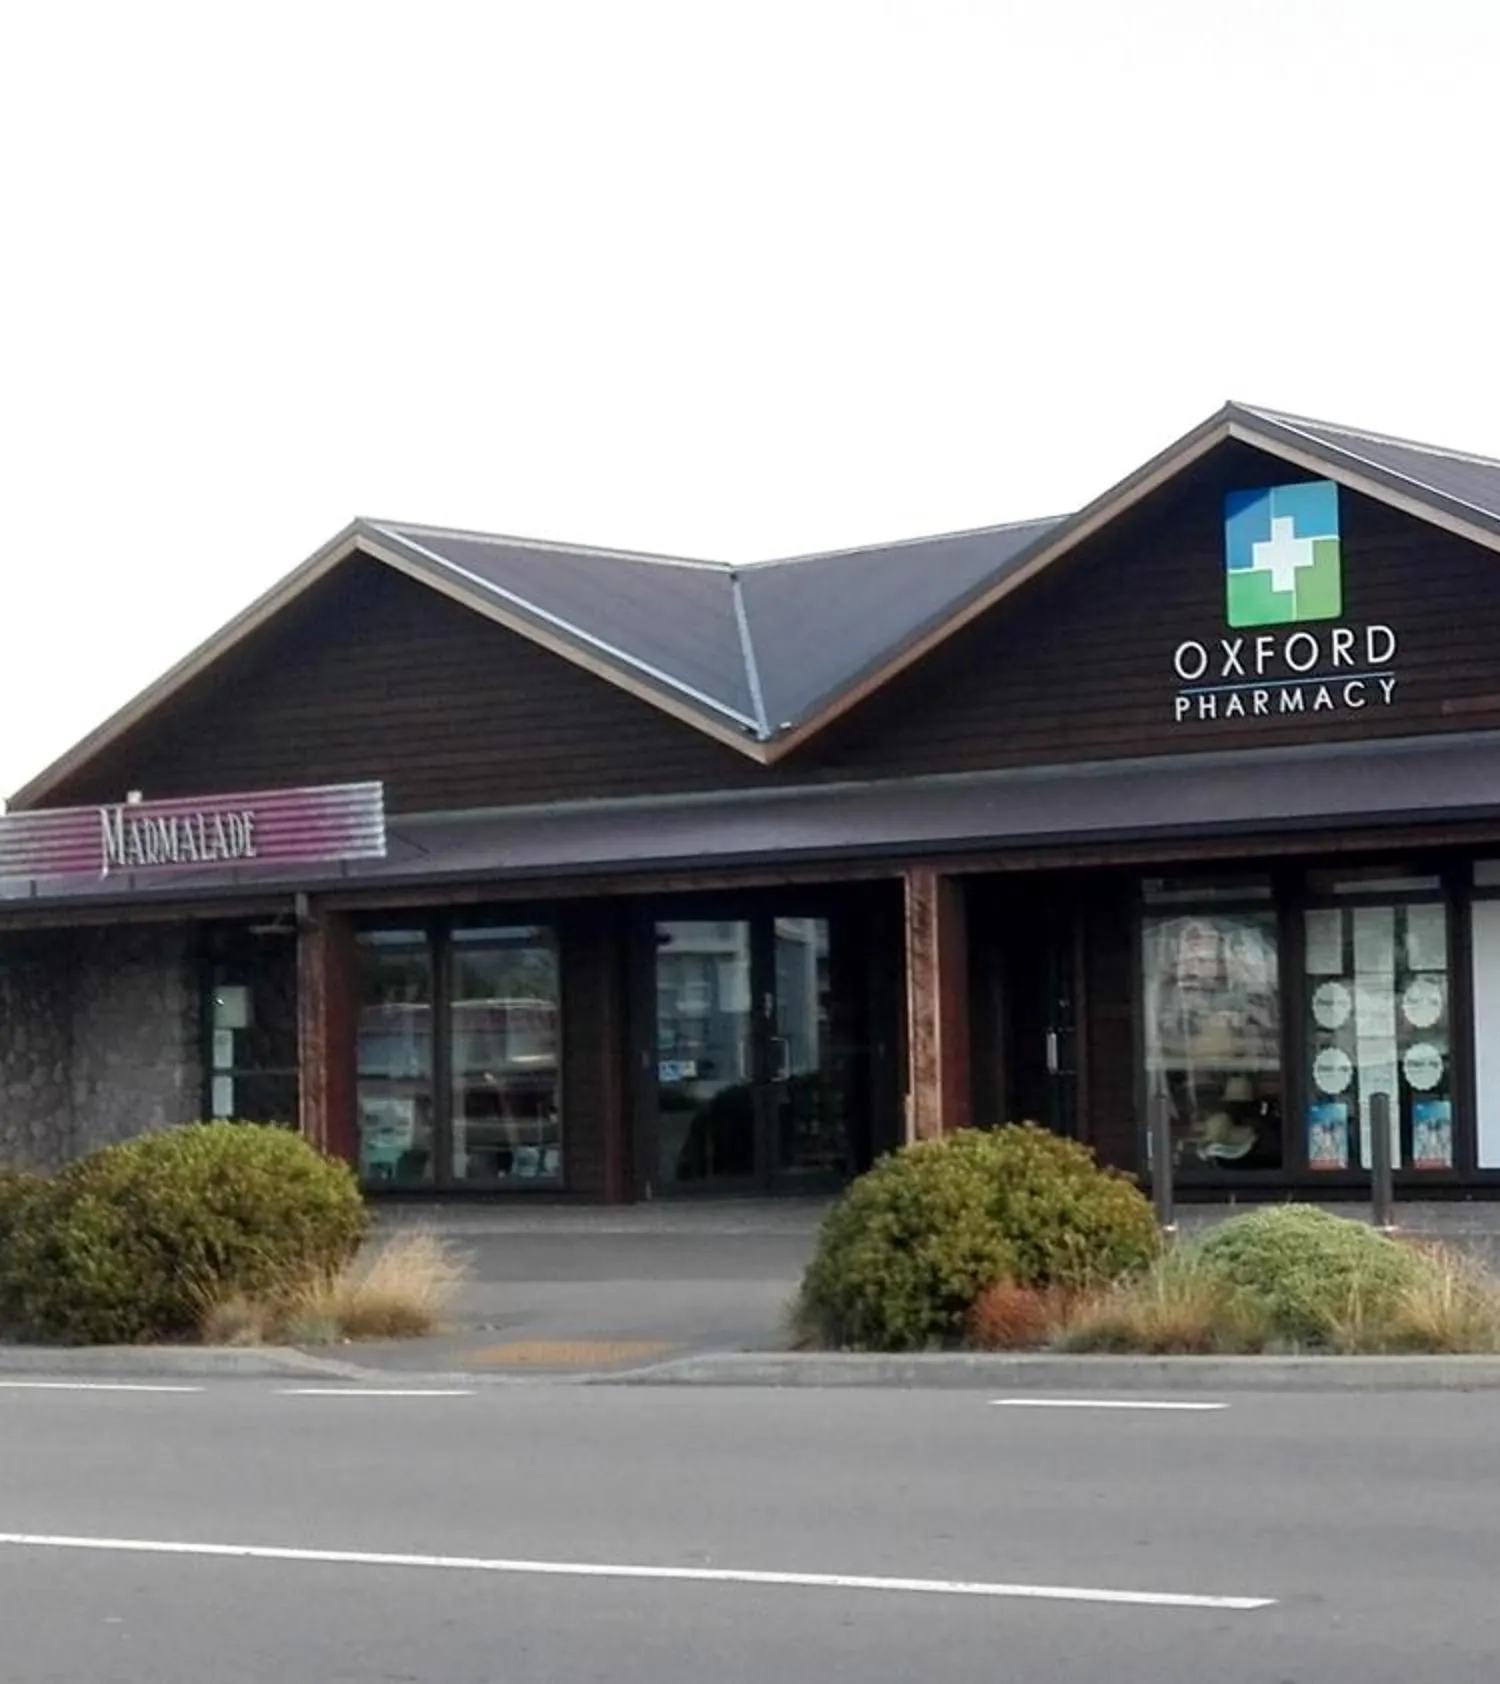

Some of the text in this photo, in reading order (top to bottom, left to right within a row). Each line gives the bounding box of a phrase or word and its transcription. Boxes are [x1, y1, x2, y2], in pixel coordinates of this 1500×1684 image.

[1173, 624, 1396, 680] OXFORD
[1175, 678, 1396, 722] PHARMACY
[100, 807, 257, 878] MARMALADE
